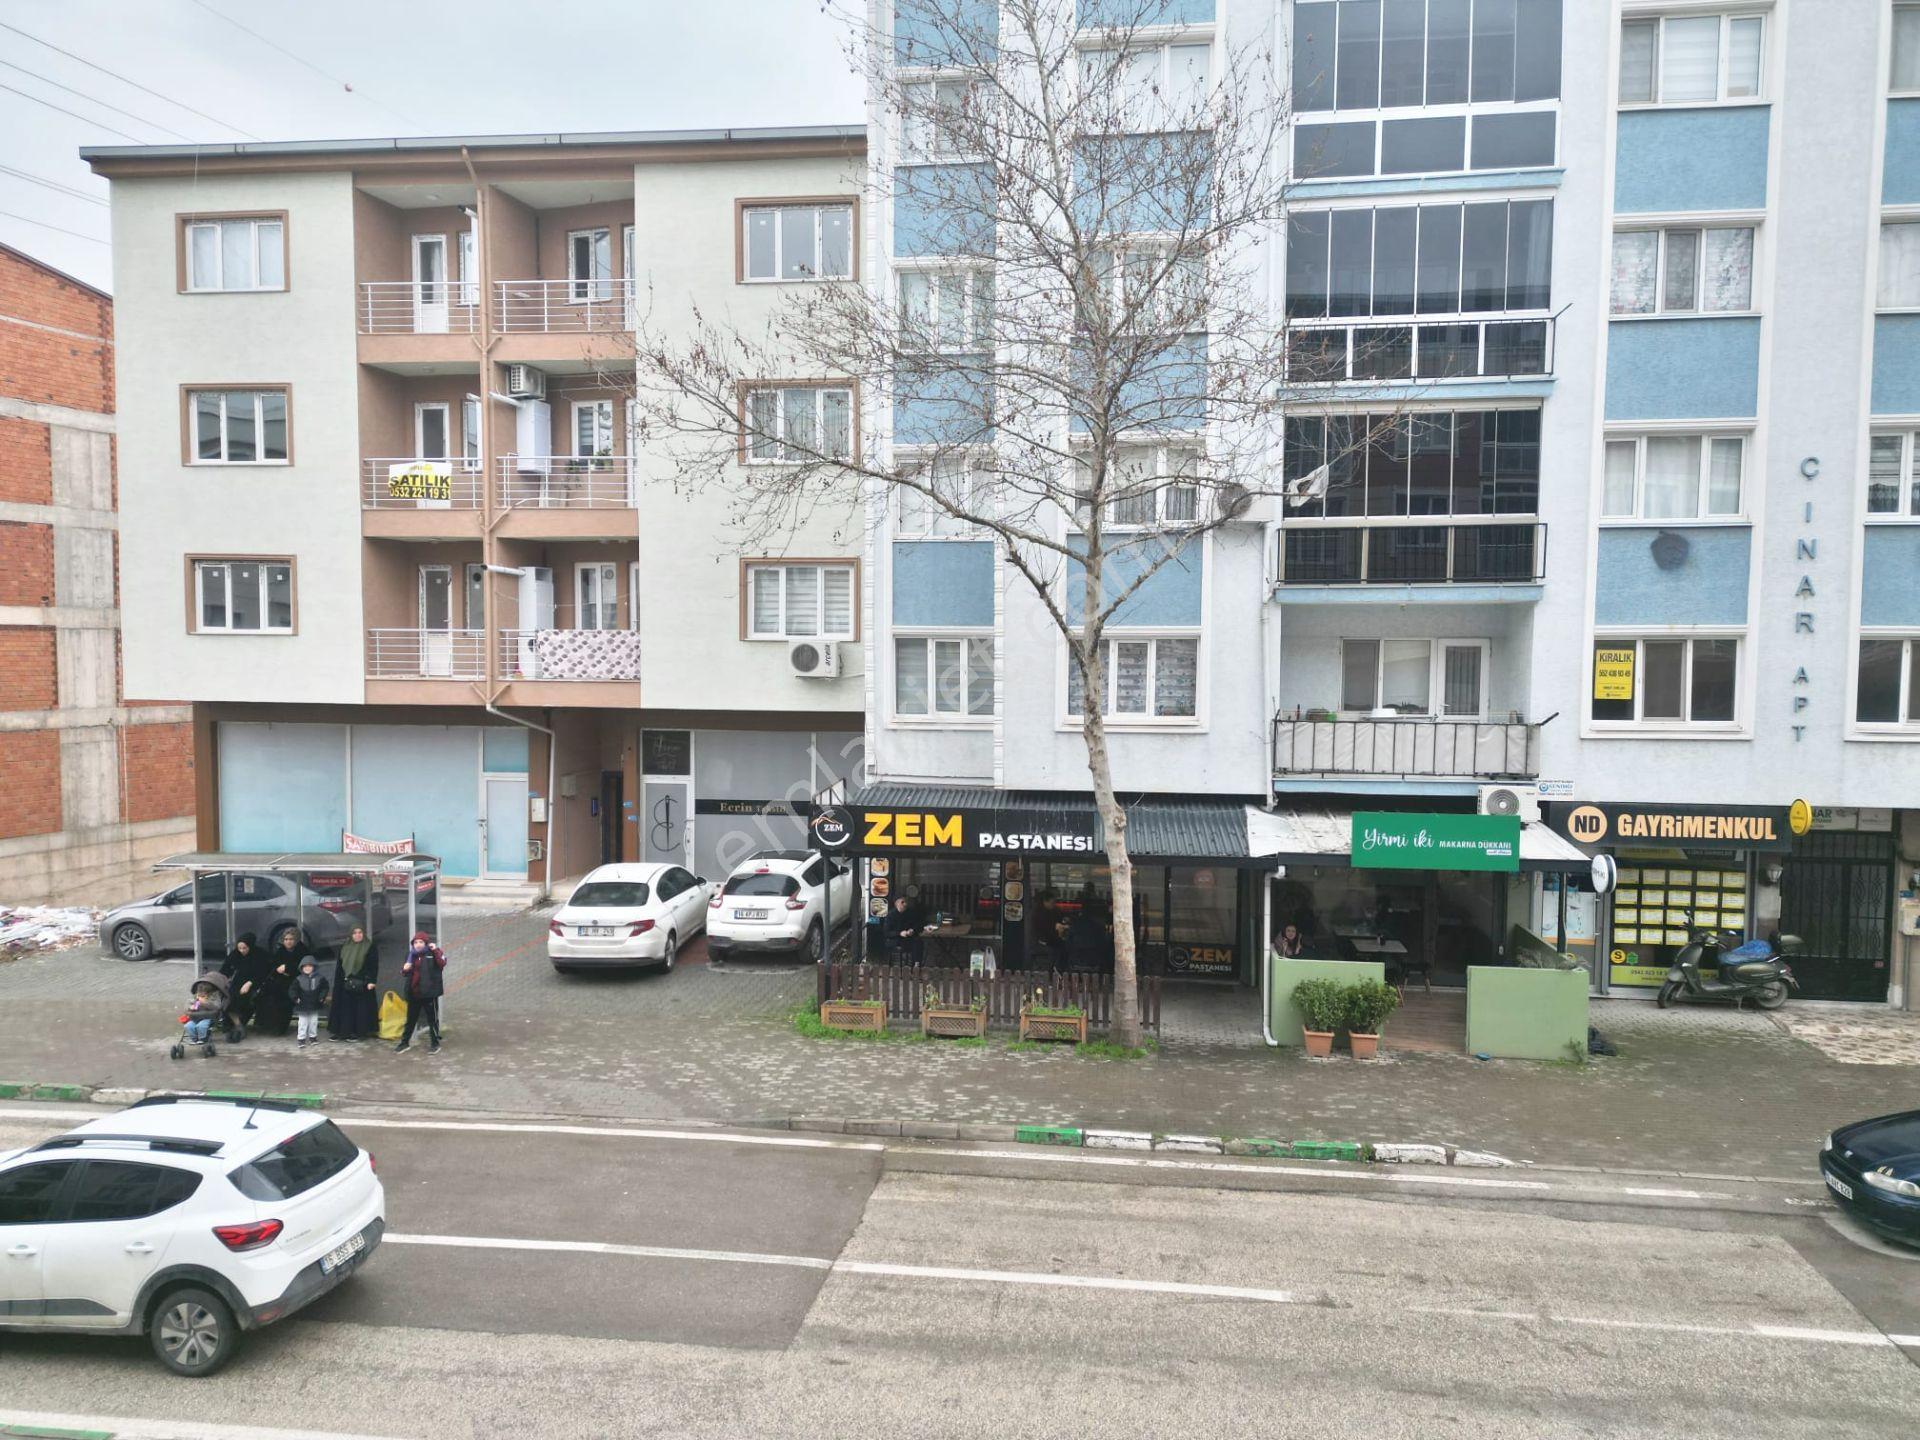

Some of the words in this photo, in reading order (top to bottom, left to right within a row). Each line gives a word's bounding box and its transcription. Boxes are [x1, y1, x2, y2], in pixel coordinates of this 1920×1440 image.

[390, 474, 450, 487] SATILIK
[390, 486, 410, 498] 0532
[429, 487, 440, 499] 19
[1794, 456, 1820, 633] ÇINAR
[1791, 666, 1810, 742] APT
[720, 802, 752, 813] Ecrin
[824, 823, 843, 832] ZEM
[864, 813, 963, 847] ZEM
[1574, 815, 1601, 834] ND
[1362, 828, 1408, 850] Yirmi
[1413, 829, 1434, 848] iki
[1439, 841, 1476, 849] MAKARNA
[1190, 947, 1232, 963] ZEM
